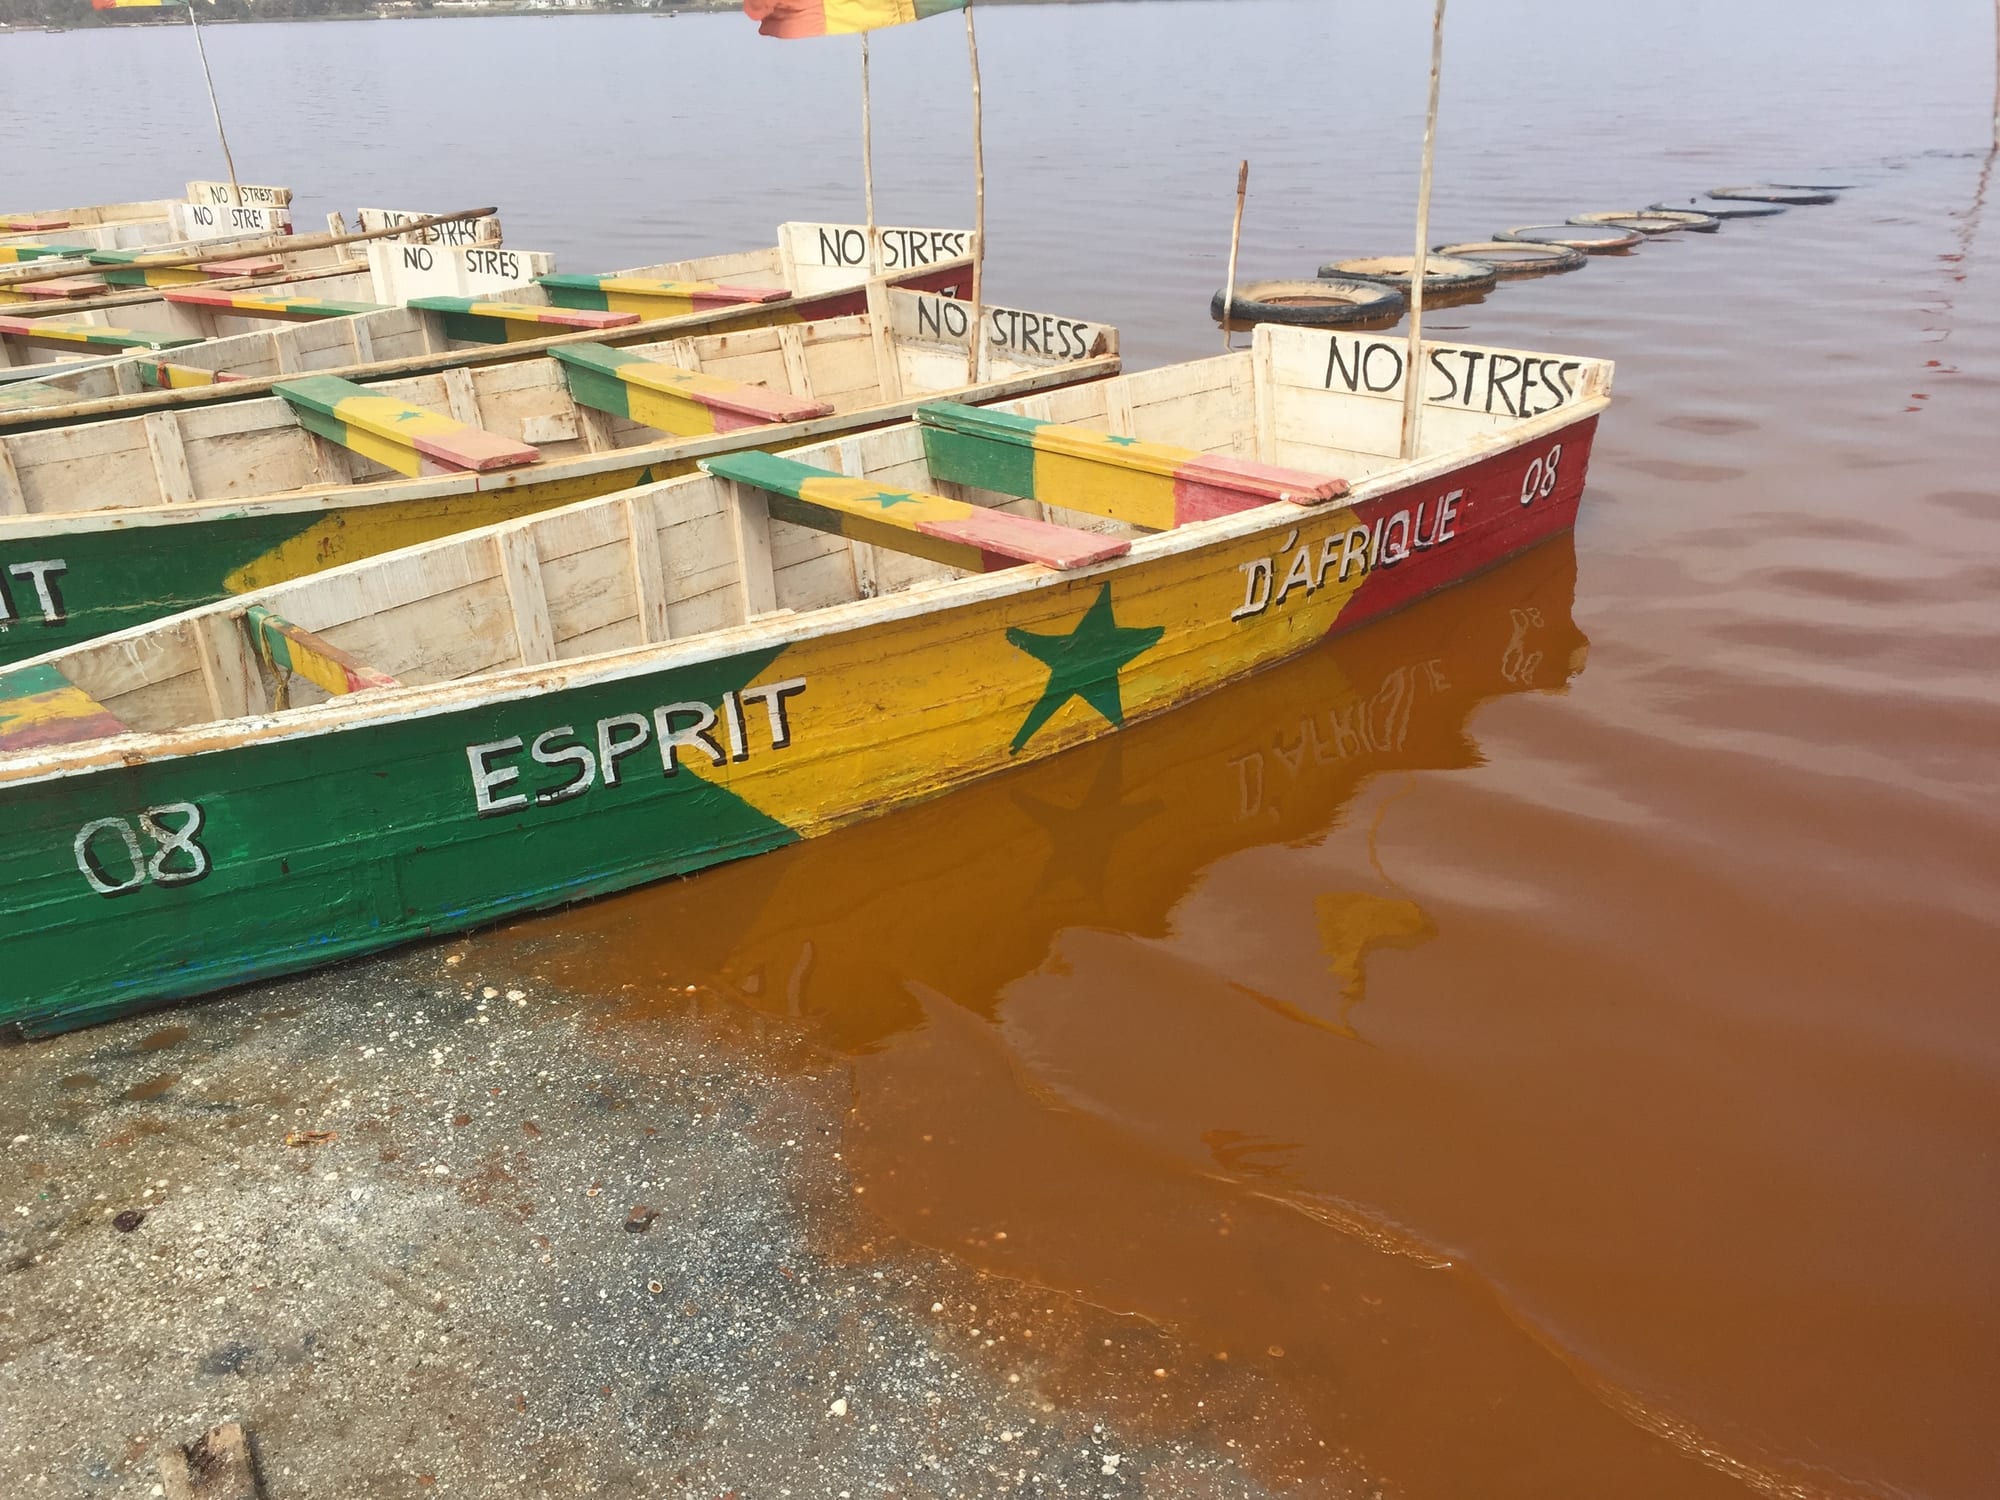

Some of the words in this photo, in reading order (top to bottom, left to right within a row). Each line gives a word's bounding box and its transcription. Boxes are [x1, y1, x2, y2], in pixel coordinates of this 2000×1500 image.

[193, 206, 214, 226] NO
[210, 186, 229, 205] NO
[404, 247, 433, 271] NO
[465, 249, 519, 280] STRES
[819, 227, 866, 266] NO
[882, 230, 966, 268] STRESS
[918, 296, 968, 338] NO
[991, 309, 1089, 360] STRESS
[1325, 336, 1402, 393] NO
[1429, 348, 1582, 418] STRESS
[1520, 444, 1562, 508] 08
[466, 677, 808, 819] ESPRIT
[73, 801, 212, 899] 08
